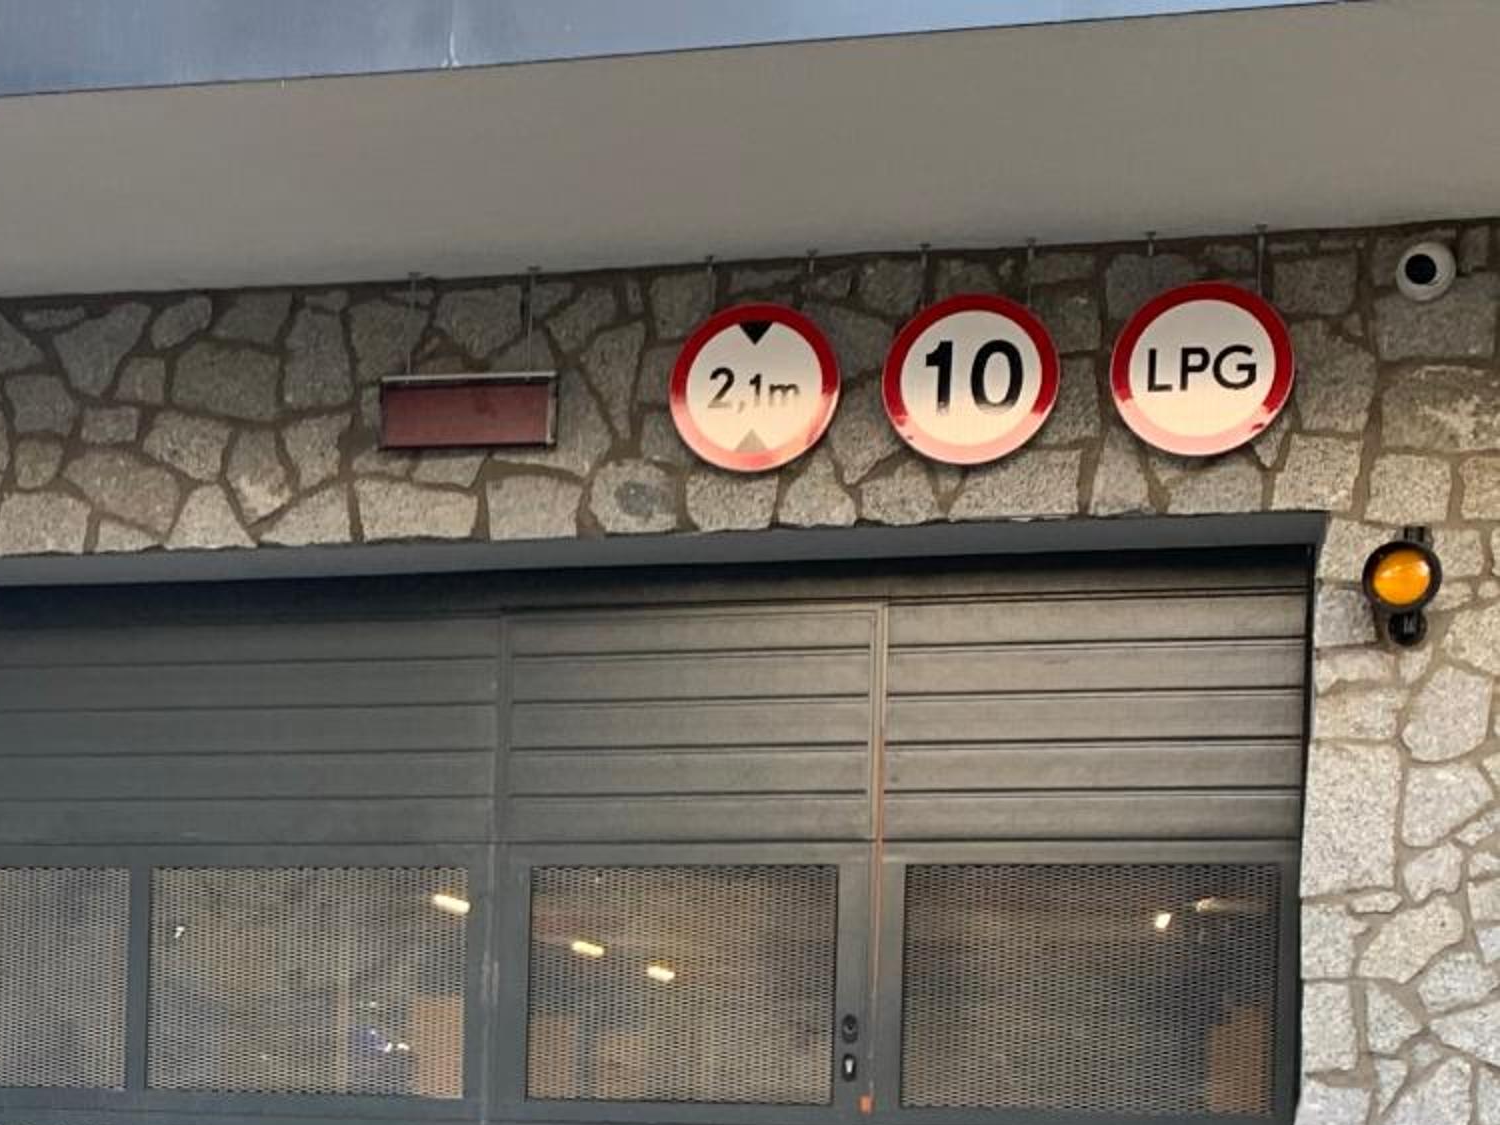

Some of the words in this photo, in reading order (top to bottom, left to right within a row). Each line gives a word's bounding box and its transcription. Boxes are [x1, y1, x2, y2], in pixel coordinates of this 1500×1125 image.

[707, 366, 800, 414] 2,1m
[925, 339, 1024, 416] 10
[1148, 344, 1257, 392] LPG
